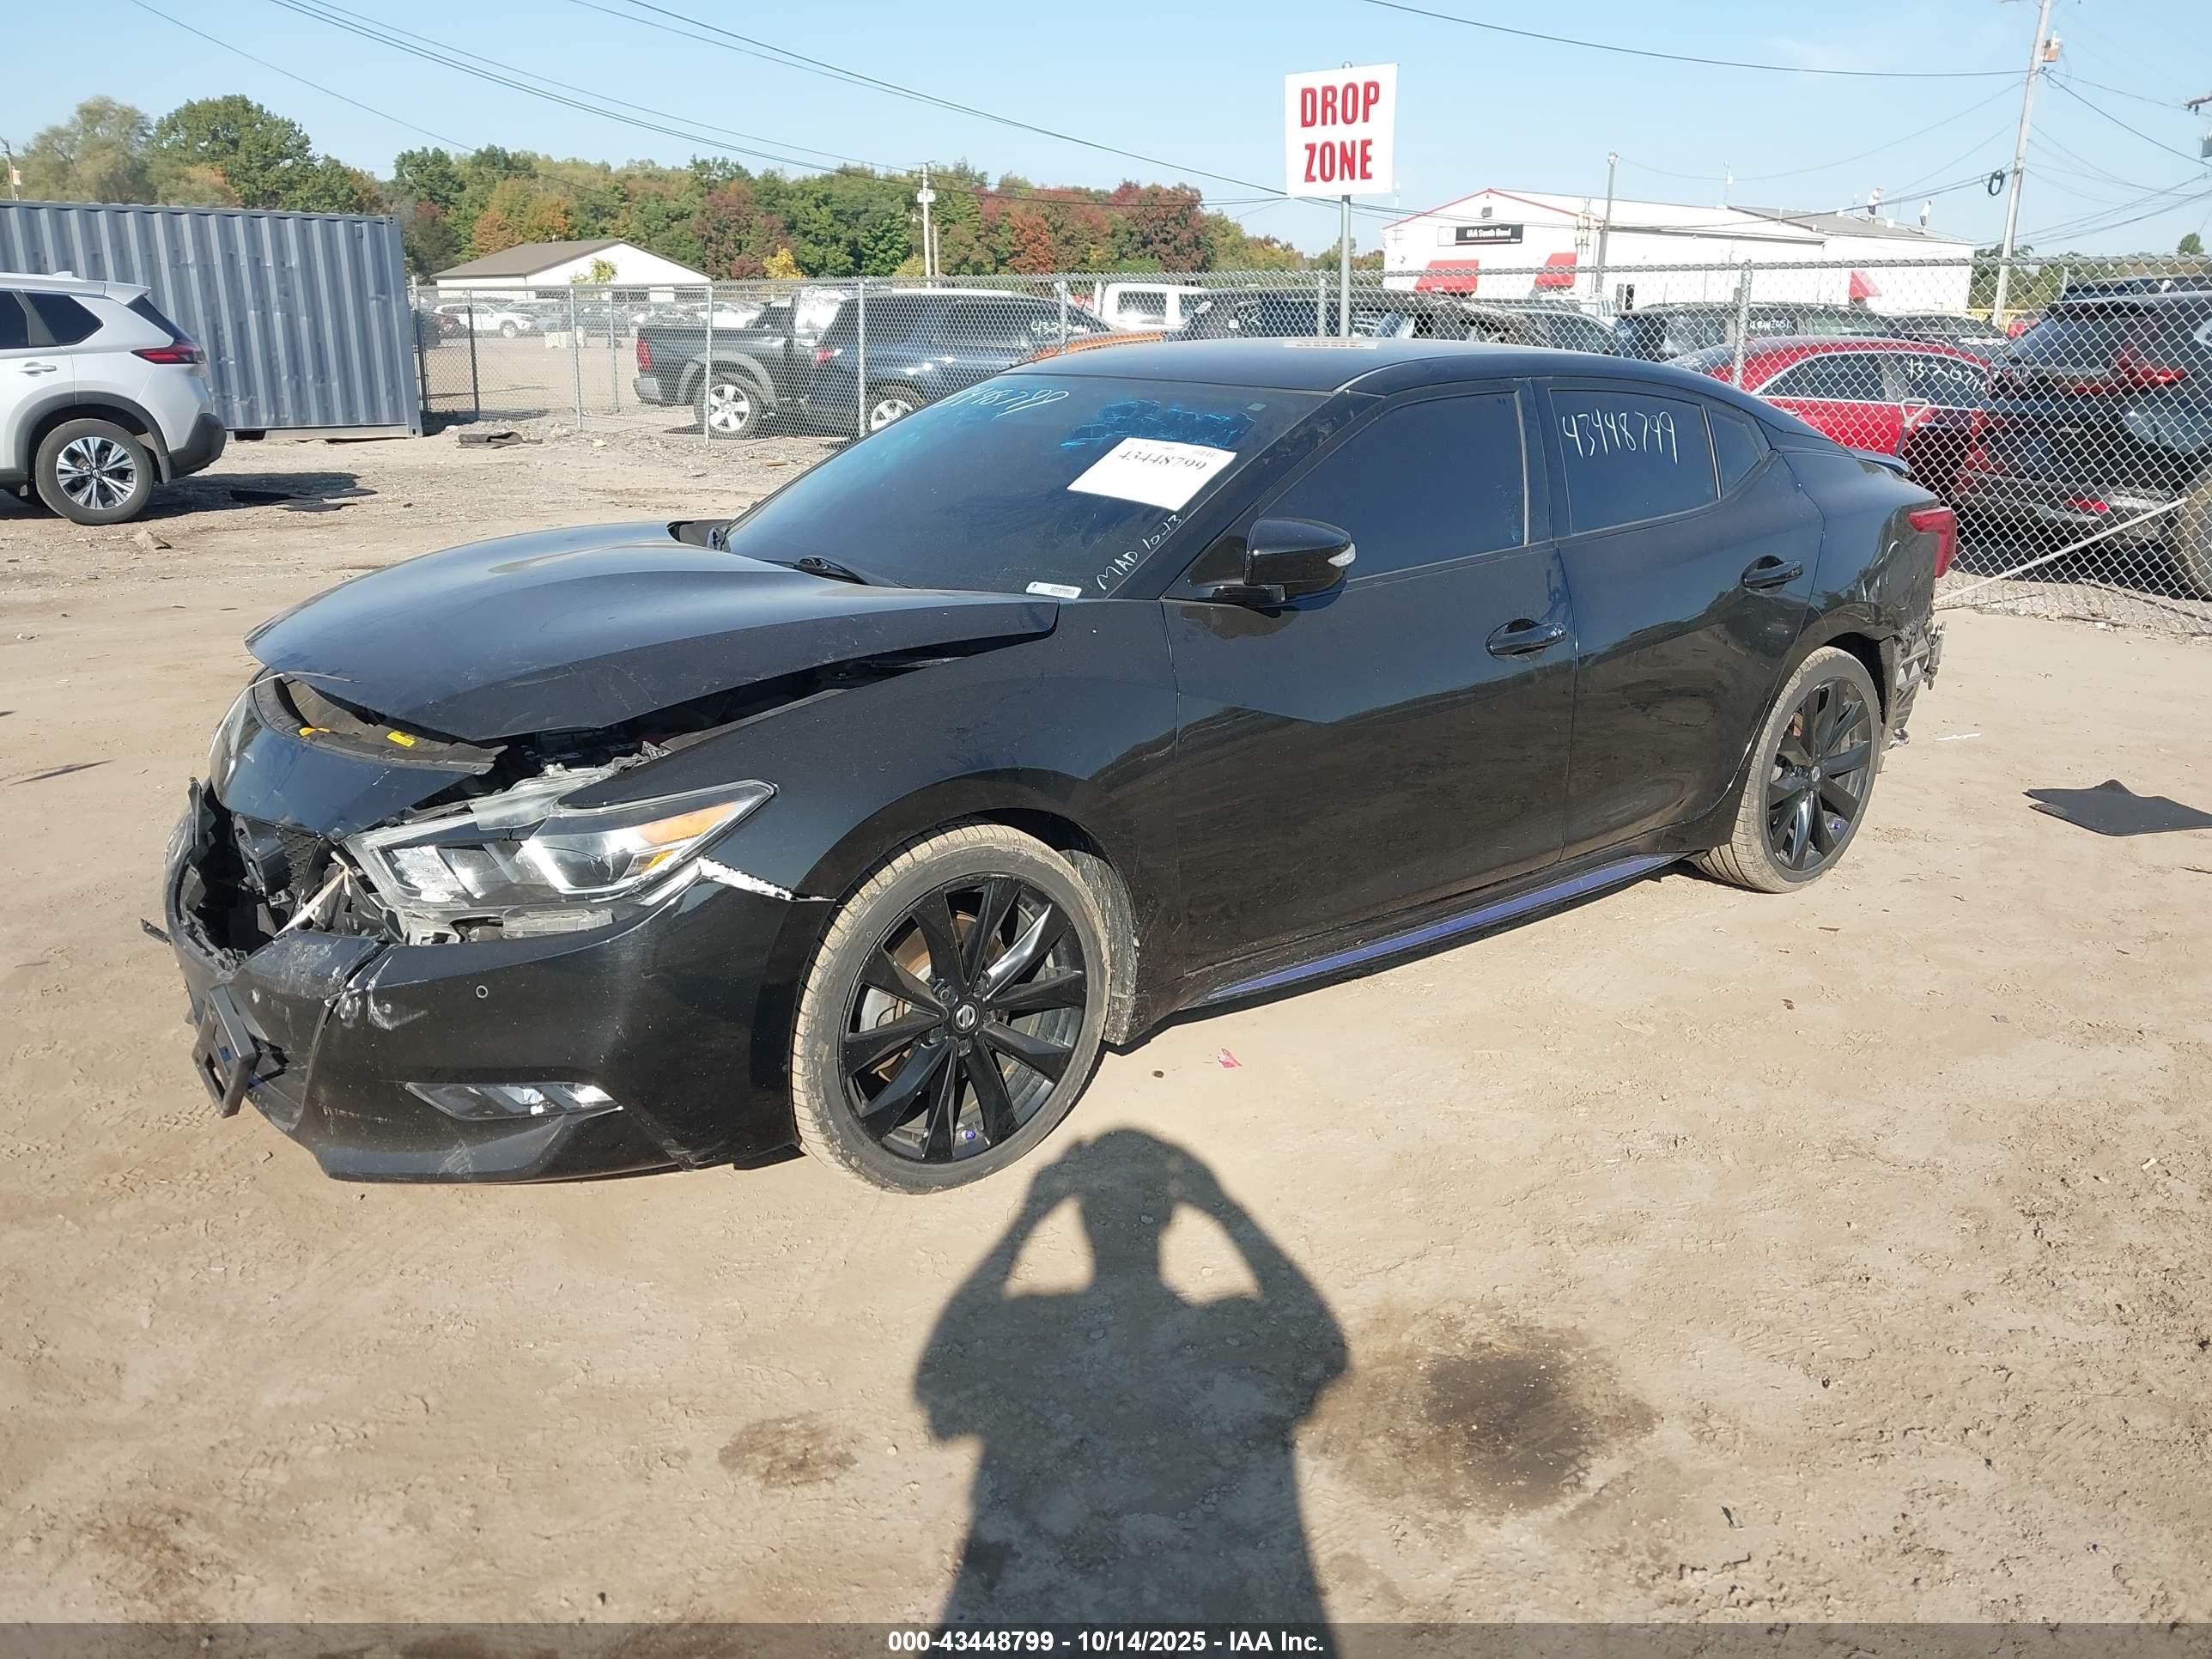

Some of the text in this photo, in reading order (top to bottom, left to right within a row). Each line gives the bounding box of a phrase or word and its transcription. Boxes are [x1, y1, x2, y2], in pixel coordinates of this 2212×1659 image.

[1300, 81, 1380, 128] DROP
[1304, 138, 1373, 183] ZONE
[1562, 407, 1678, 466] 43448799
[1119, 450, 1206, 471] 43448799
[1096, 550, 1139, 591] MAD
